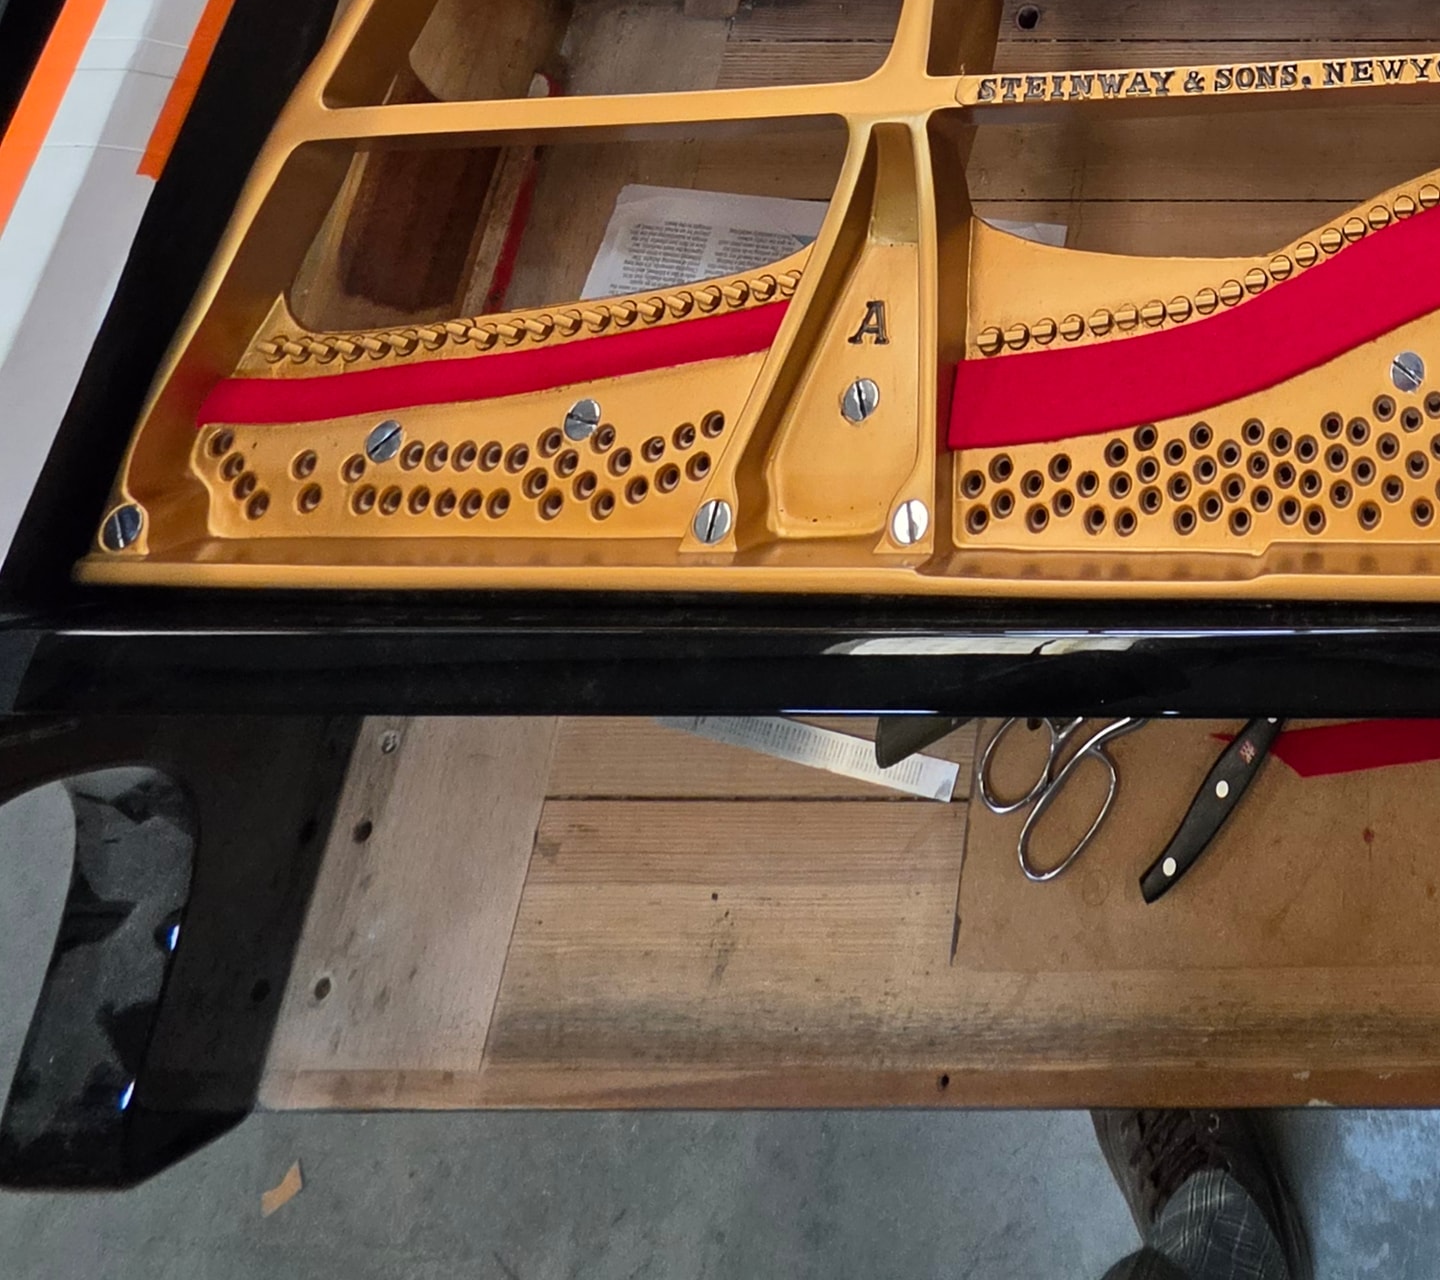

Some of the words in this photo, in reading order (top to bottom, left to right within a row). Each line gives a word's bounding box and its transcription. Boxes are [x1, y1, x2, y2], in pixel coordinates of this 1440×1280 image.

[977, 70, 1175, 102] STEINWAY
[1184, 70, 1205, 91] &
[1214, 63, 1311, 92] SONS.
[847, 300, 890, 345] A
